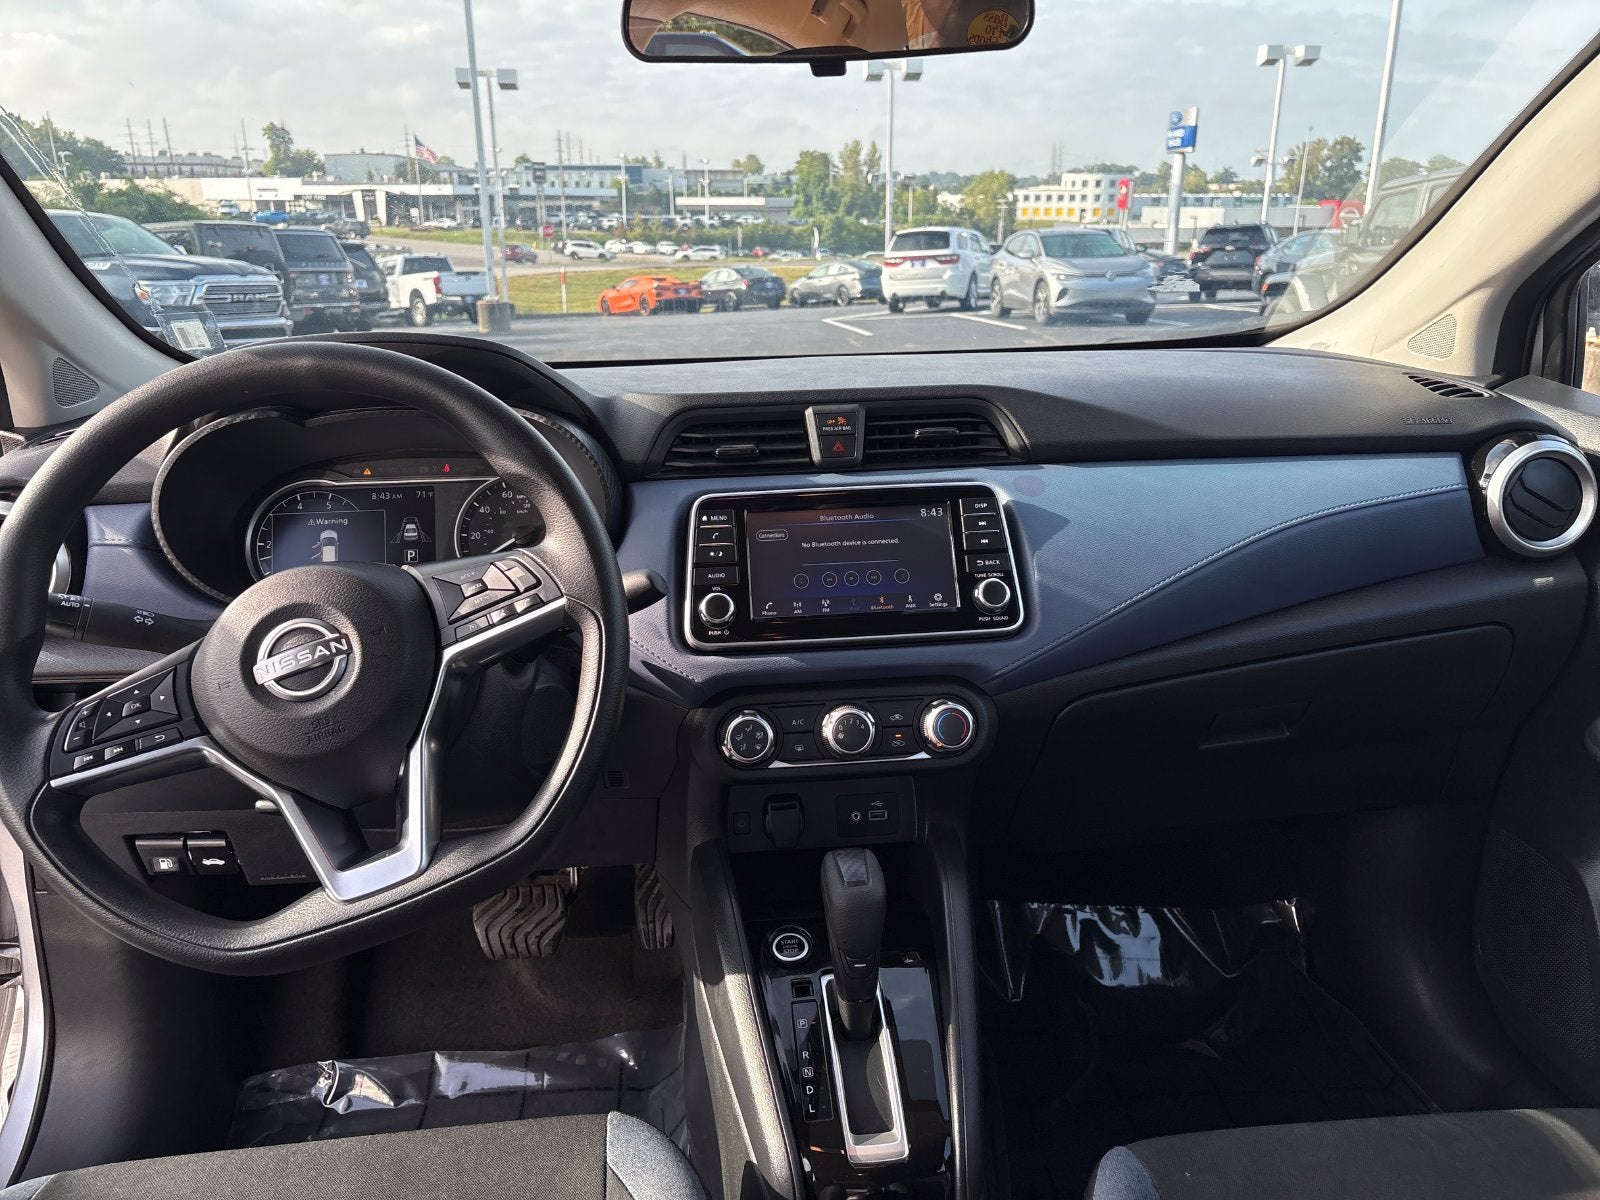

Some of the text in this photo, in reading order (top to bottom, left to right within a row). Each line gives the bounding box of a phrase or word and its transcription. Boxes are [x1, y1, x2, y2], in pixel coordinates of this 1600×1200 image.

[371, 492, 391, 500] 8:43
[501, 490, 513, 499] 60
[297, 502, 303, 510] 4
[326, 501, 332, 509] 5
[479, 506, 491, 514] 40
[920, 507, 944, 517] 8:43
[315, 518, 349, 526] Warning
[470, 531, 481, 540] 20
[265, 540, 272, 549] 2
[811, 540, 841, 548] Bluetooth
[407, 550, 416, 562] P
[60, 600, 81, 608] AUTO
[254, 638, 349, 681] NISSAN
[802, 1051, 810, 1060] R
[804, 1068, 812, 1076] N
[806, 1085, 814, 1095] D
[808, 1104, 816, 1113] L
